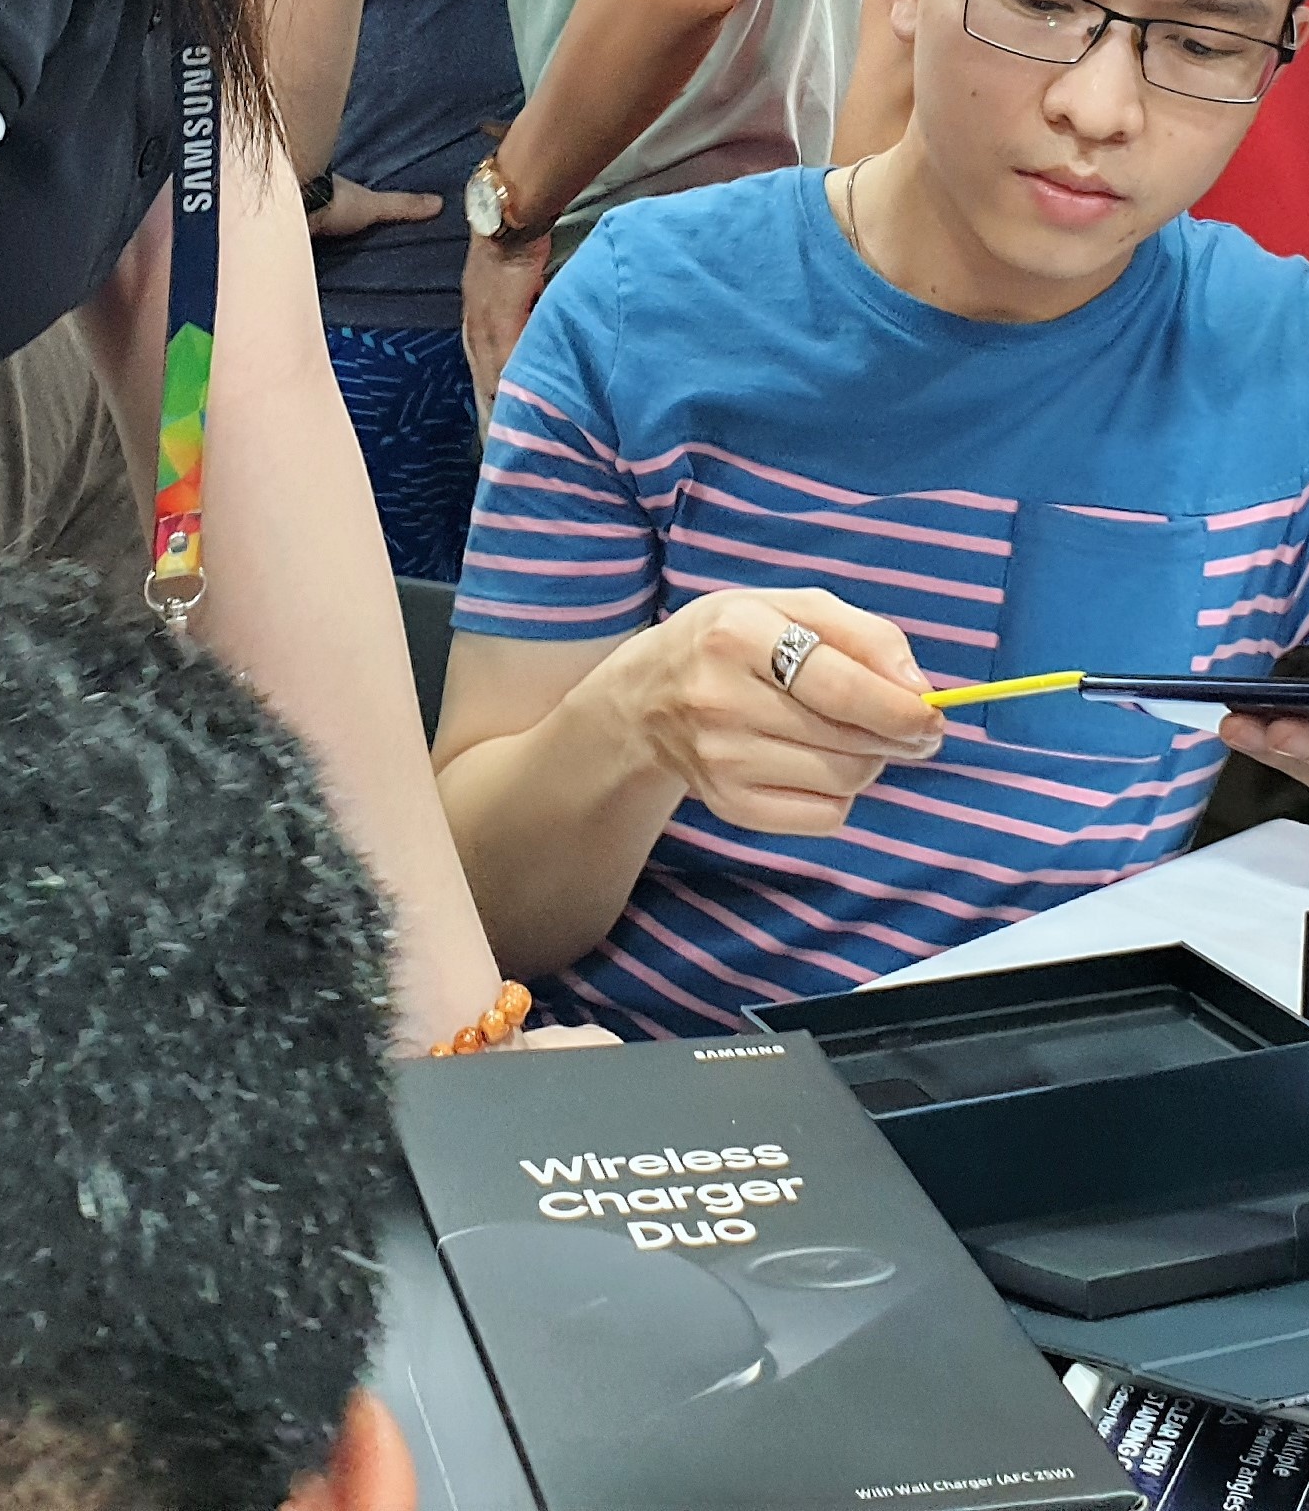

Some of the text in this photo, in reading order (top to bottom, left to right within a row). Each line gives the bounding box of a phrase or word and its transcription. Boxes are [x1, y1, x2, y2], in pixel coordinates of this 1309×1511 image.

[182, 44, 214, 214] SAMSUNG
[693, 1044, 786, 1061] SAMSUNG
[519, 1143, 790, 1186] Wireless
[538, 1174, 804, 1221] Charger
[626, 1218, 758, 1251] Duo
[1117, 1390, 1169, 1458] STANDING
[1139, 1438, 1176, 1478] VIEW
[855, 1487, 894, 1501] With
[894, 1481, 932, 1496] Wall
[932, 1477, 994, 1492] Charger
[1223, 1465, 1260, 1511] angles
